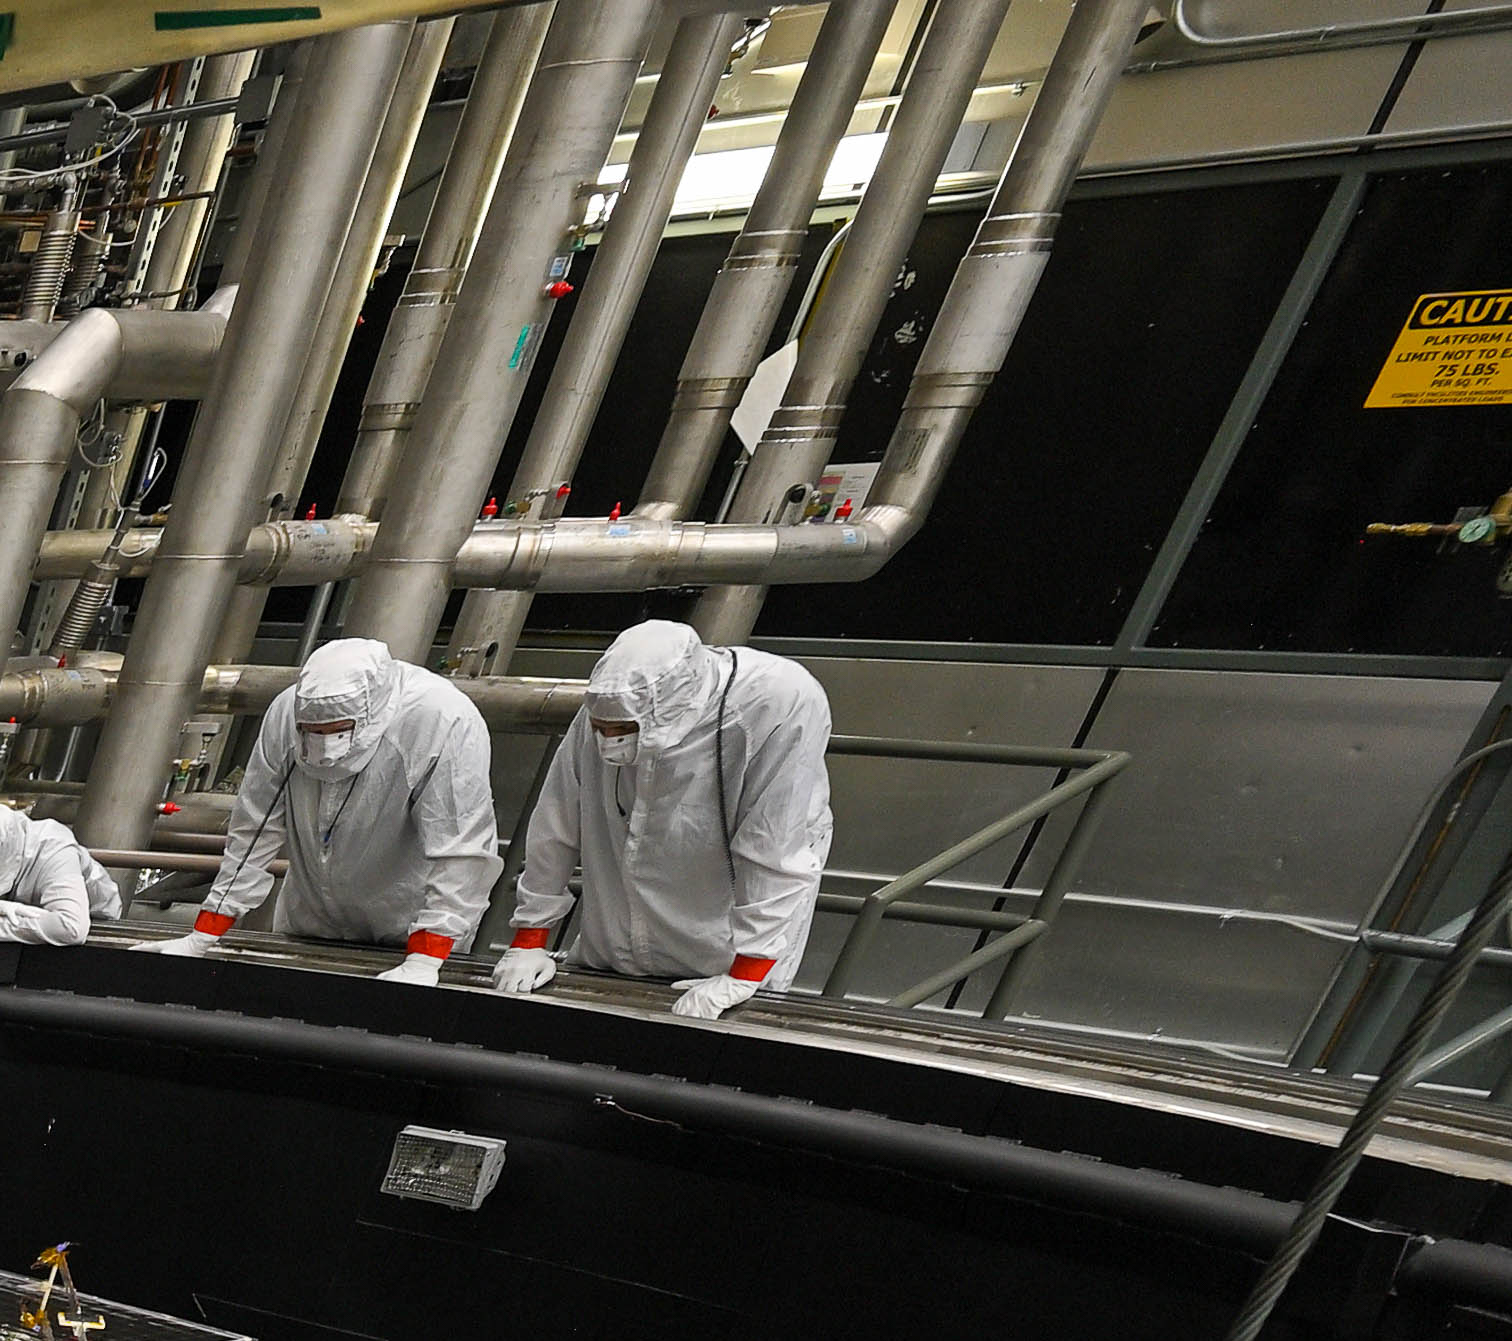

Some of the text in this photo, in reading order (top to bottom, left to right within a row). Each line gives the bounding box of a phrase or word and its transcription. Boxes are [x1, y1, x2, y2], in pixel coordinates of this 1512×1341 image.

[1420, 296, 1512, 325] CAUT
[1423, 333, 1503, 346] PLATFORM
[1395, 351, 1440, 363] LIMIT
[1441, 350, 1475, 361] NOT
[1478, 348, 1498, 360] TO
[1434, 362, 1501, 378] 75 LBS.
[1430, 379, 1454, 389] PER
